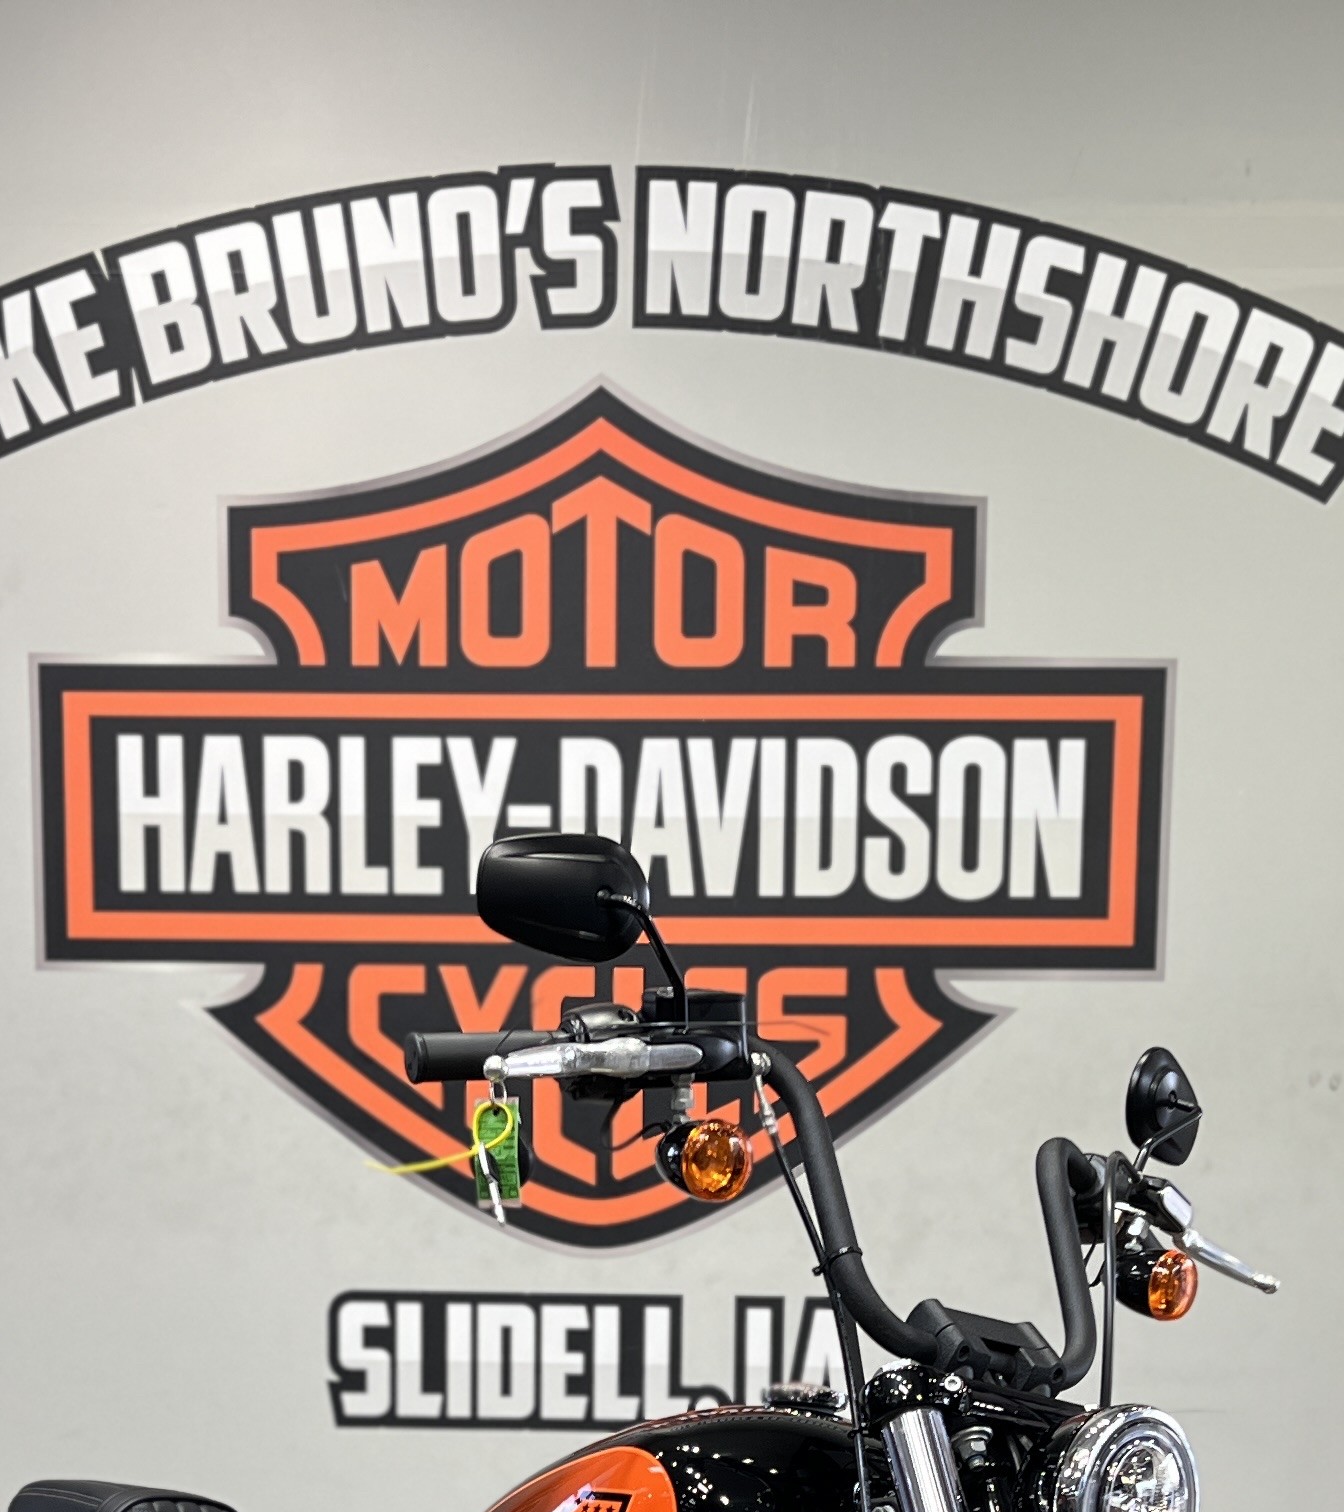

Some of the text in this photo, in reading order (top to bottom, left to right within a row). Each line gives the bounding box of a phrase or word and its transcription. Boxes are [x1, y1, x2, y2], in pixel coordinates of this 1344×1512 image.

[118, 177, 612, 386] BRUNO'S
[351, 475, 857, 668] MOTOR
[116, 734, 1087, 900] HARLEY-DAVIDSON
